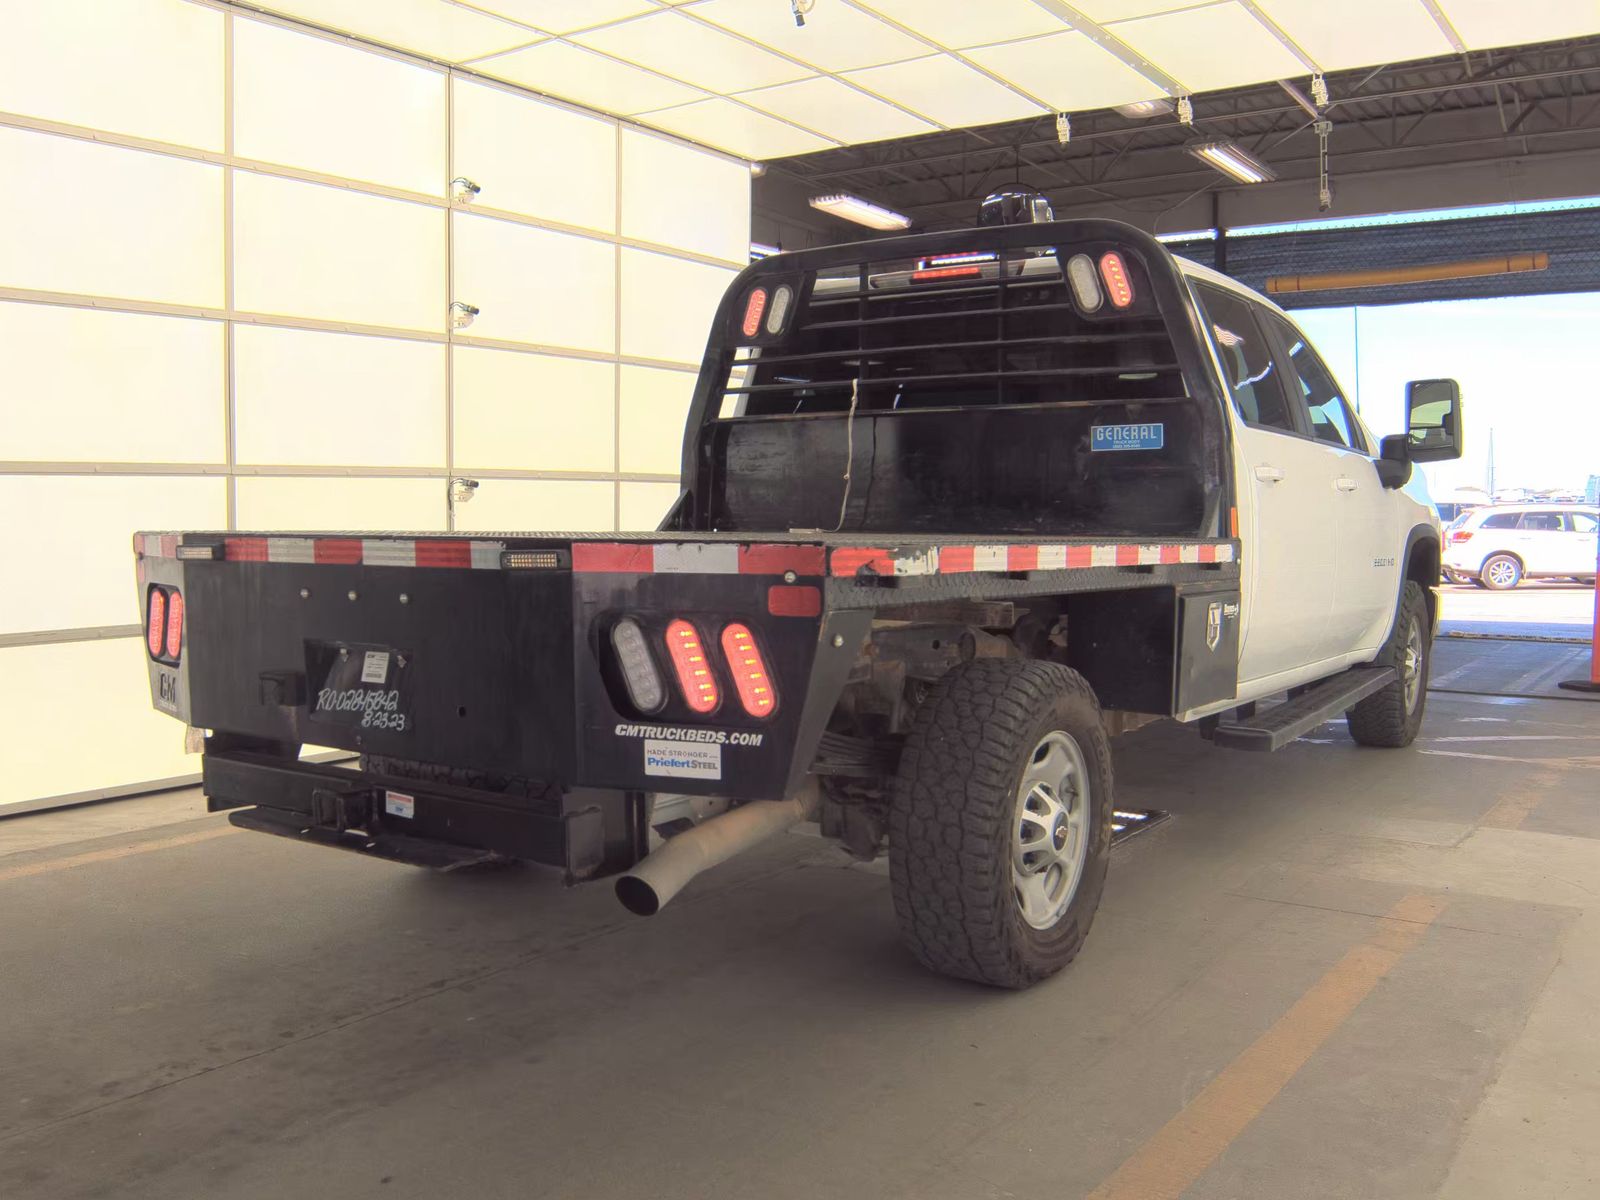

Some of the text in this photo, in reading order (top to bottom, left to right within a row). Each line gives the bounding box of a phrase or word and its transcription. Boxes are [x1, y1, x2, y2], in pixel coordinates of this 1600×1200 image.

[1096, 426, 1157, 440] GENERAL
[614, 724, 763, 746] CMTRUCKBEDS.COM
[669, 750, 708, 758] STRONGER
